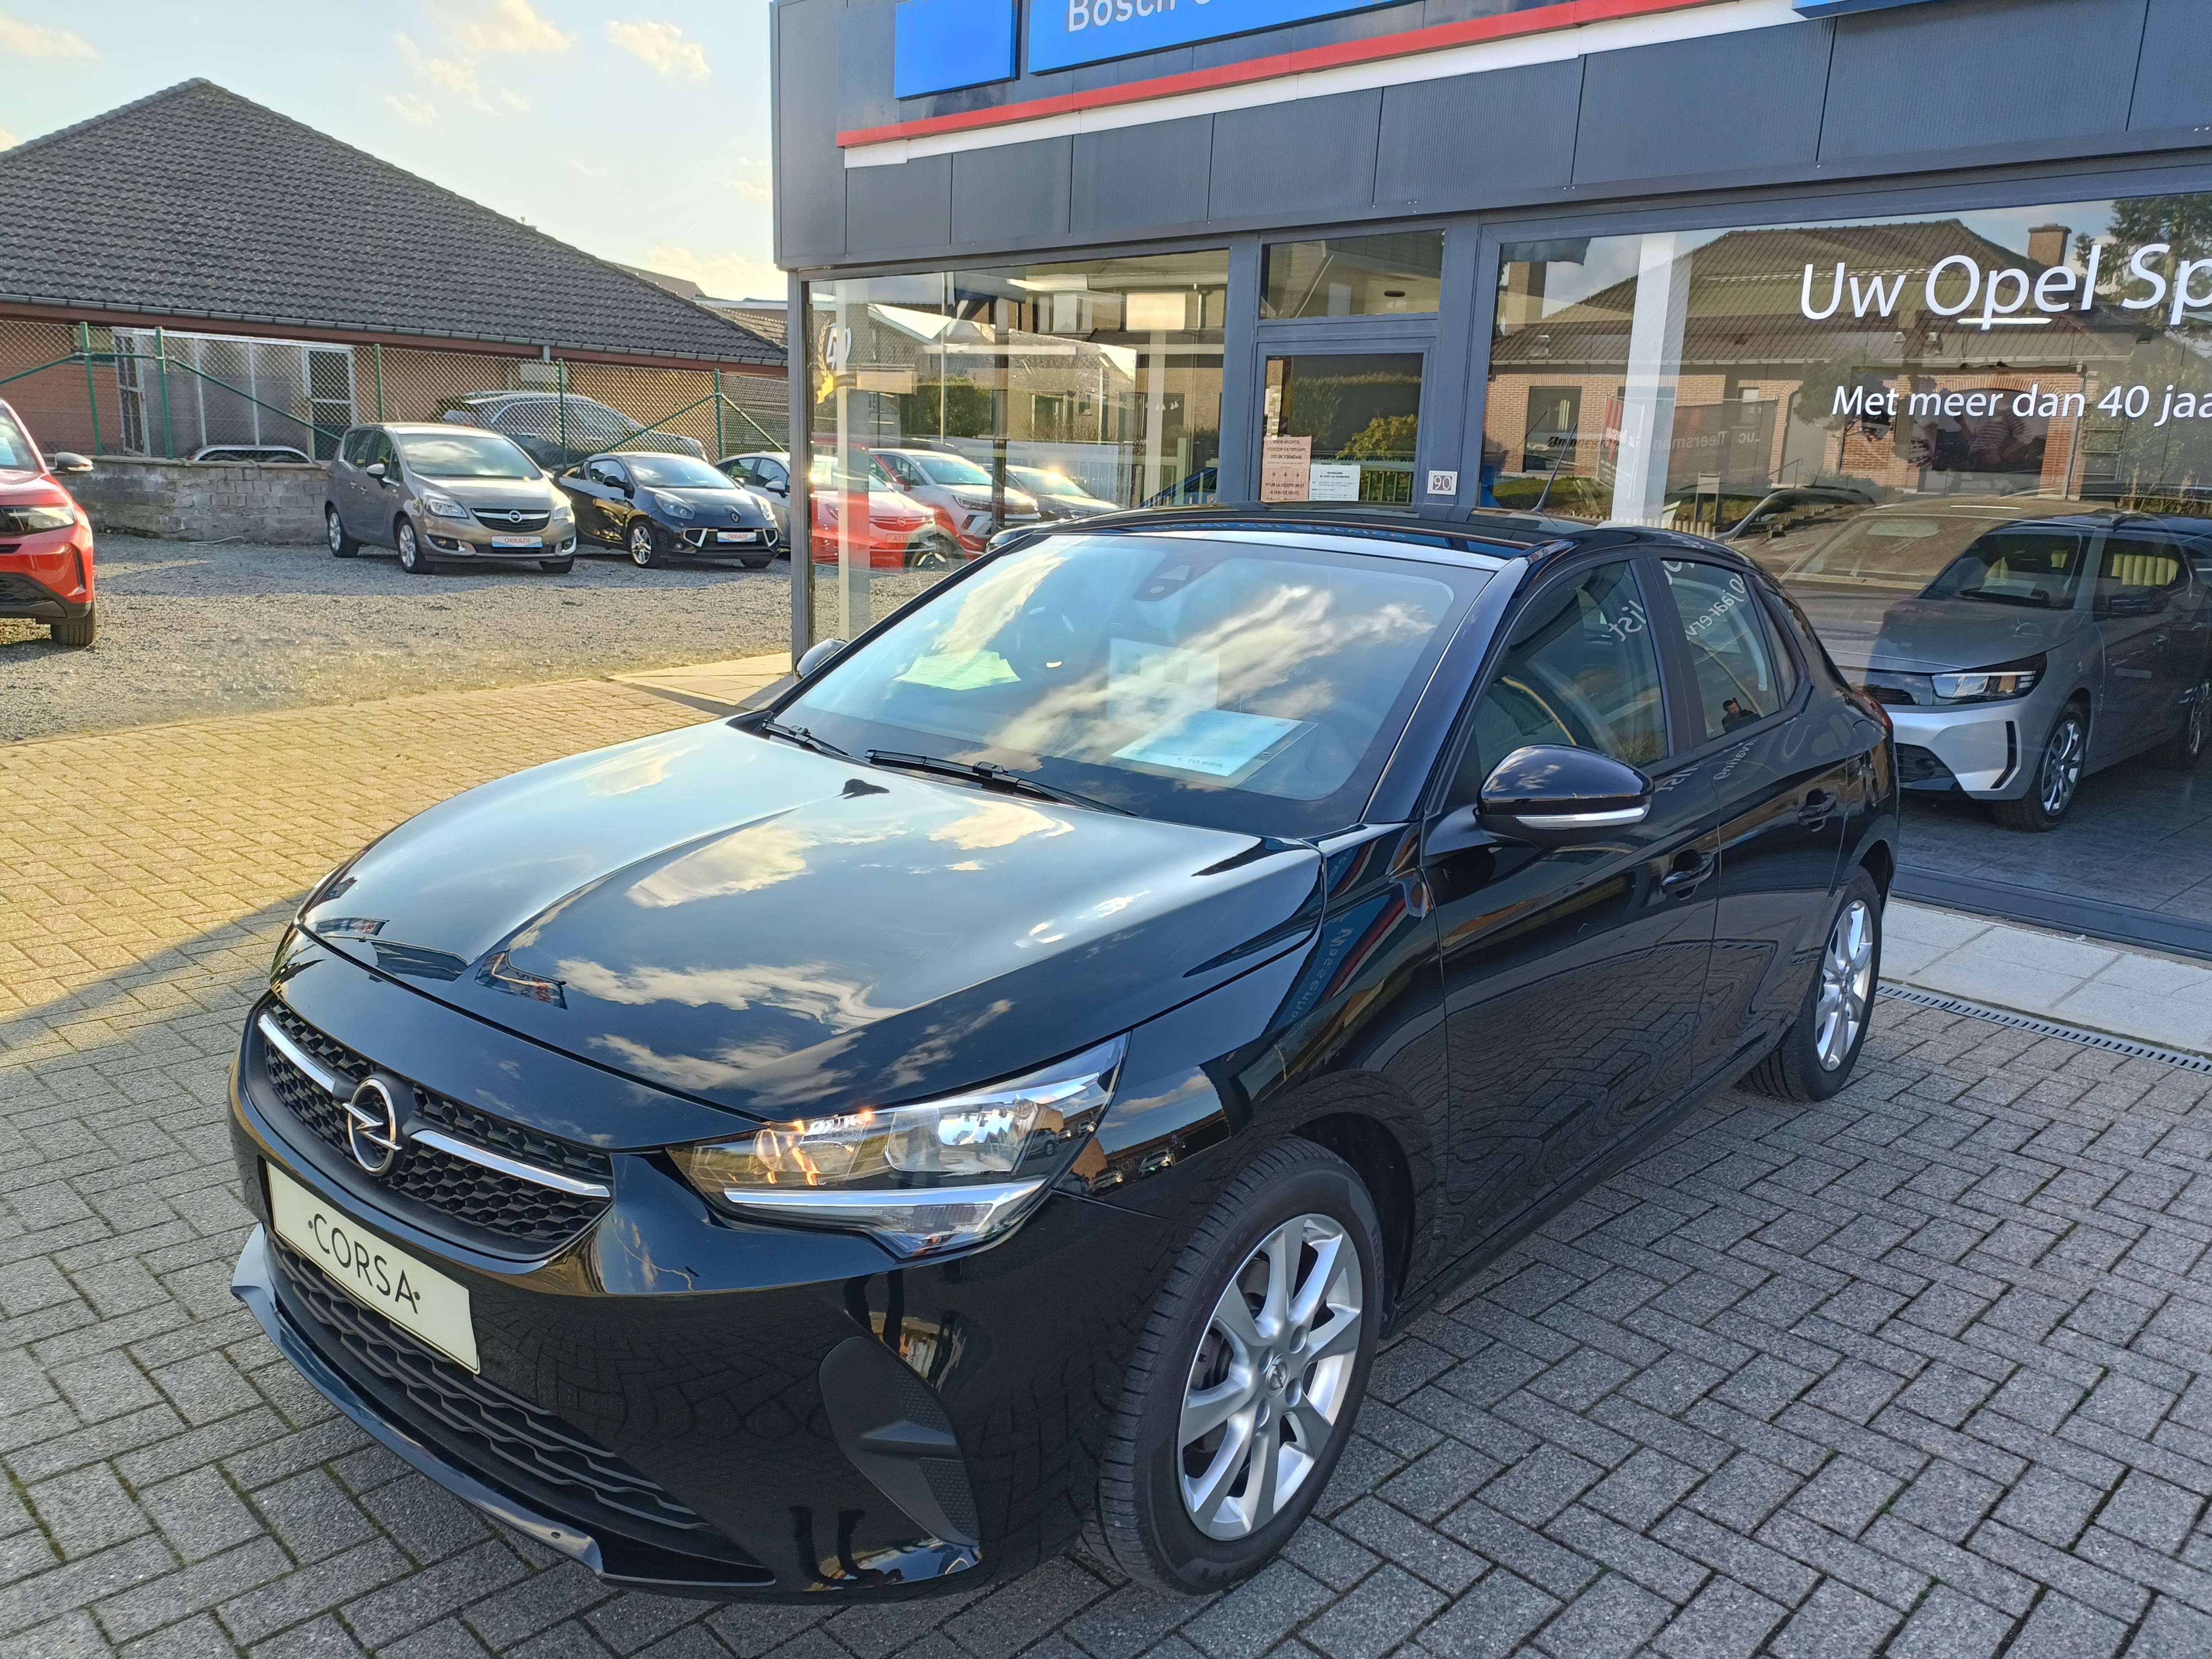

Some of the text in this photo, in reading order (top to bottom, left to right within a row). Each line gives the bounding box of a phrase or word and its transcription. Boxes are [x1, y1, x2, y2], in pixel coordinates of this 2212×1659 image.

[1801, 243, 2212, 330] Uw Opel Sp
[1832, 384, 2212, 427] Met meer dan 40 jaa
[1434, 476, 1451, 490] 90
[314, 1213, 418, 1315] CORSA
